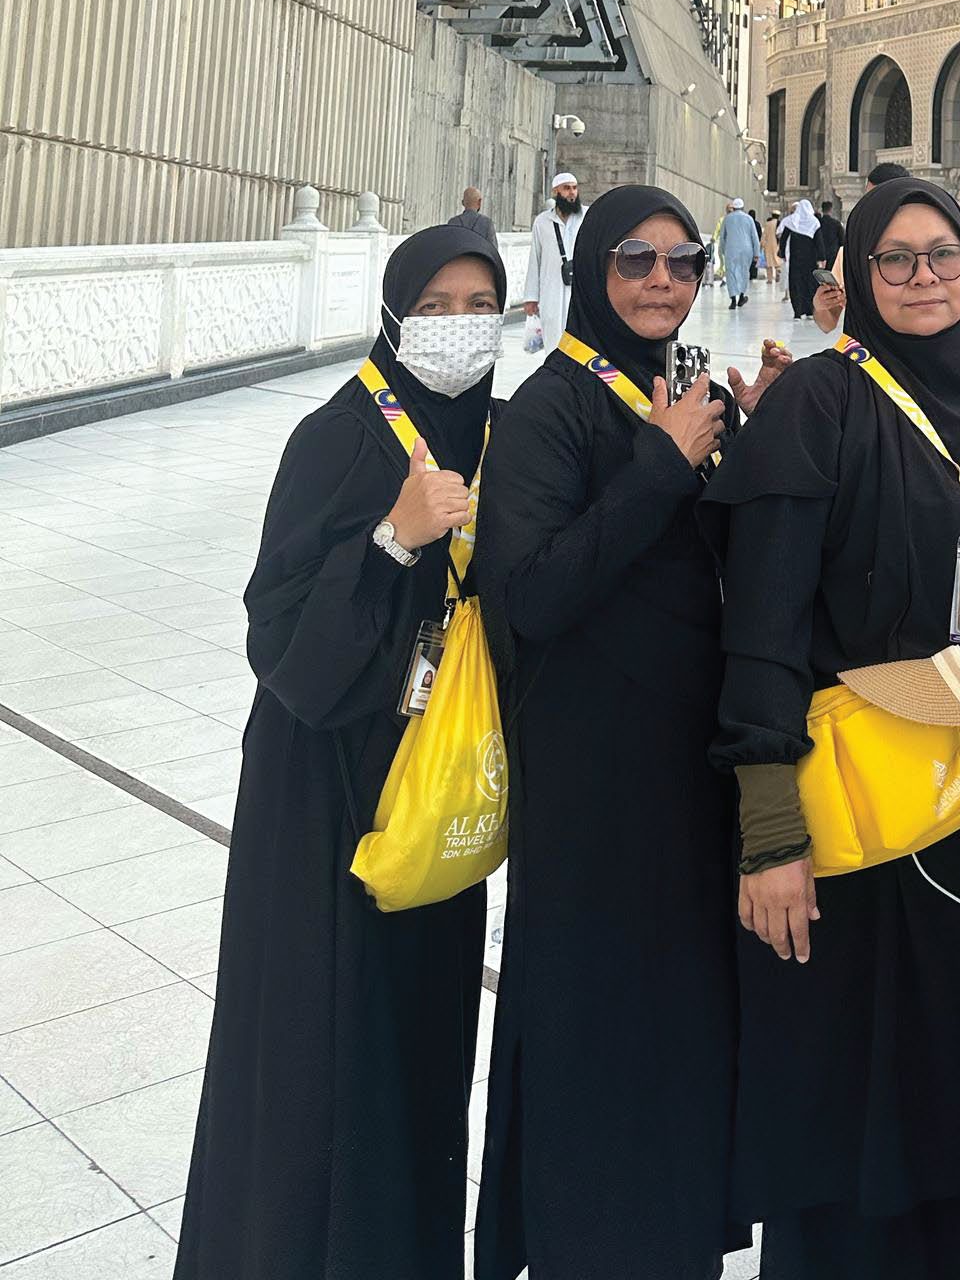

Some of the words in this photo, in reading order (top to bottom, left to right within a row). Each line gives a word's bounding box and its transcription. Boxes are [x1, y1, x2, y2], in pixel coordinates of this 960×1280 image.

[444, 816, 470, 835] AL
[446, 834, 485, 848] TRAVEL
[441, 849, 461, 859] SDN
